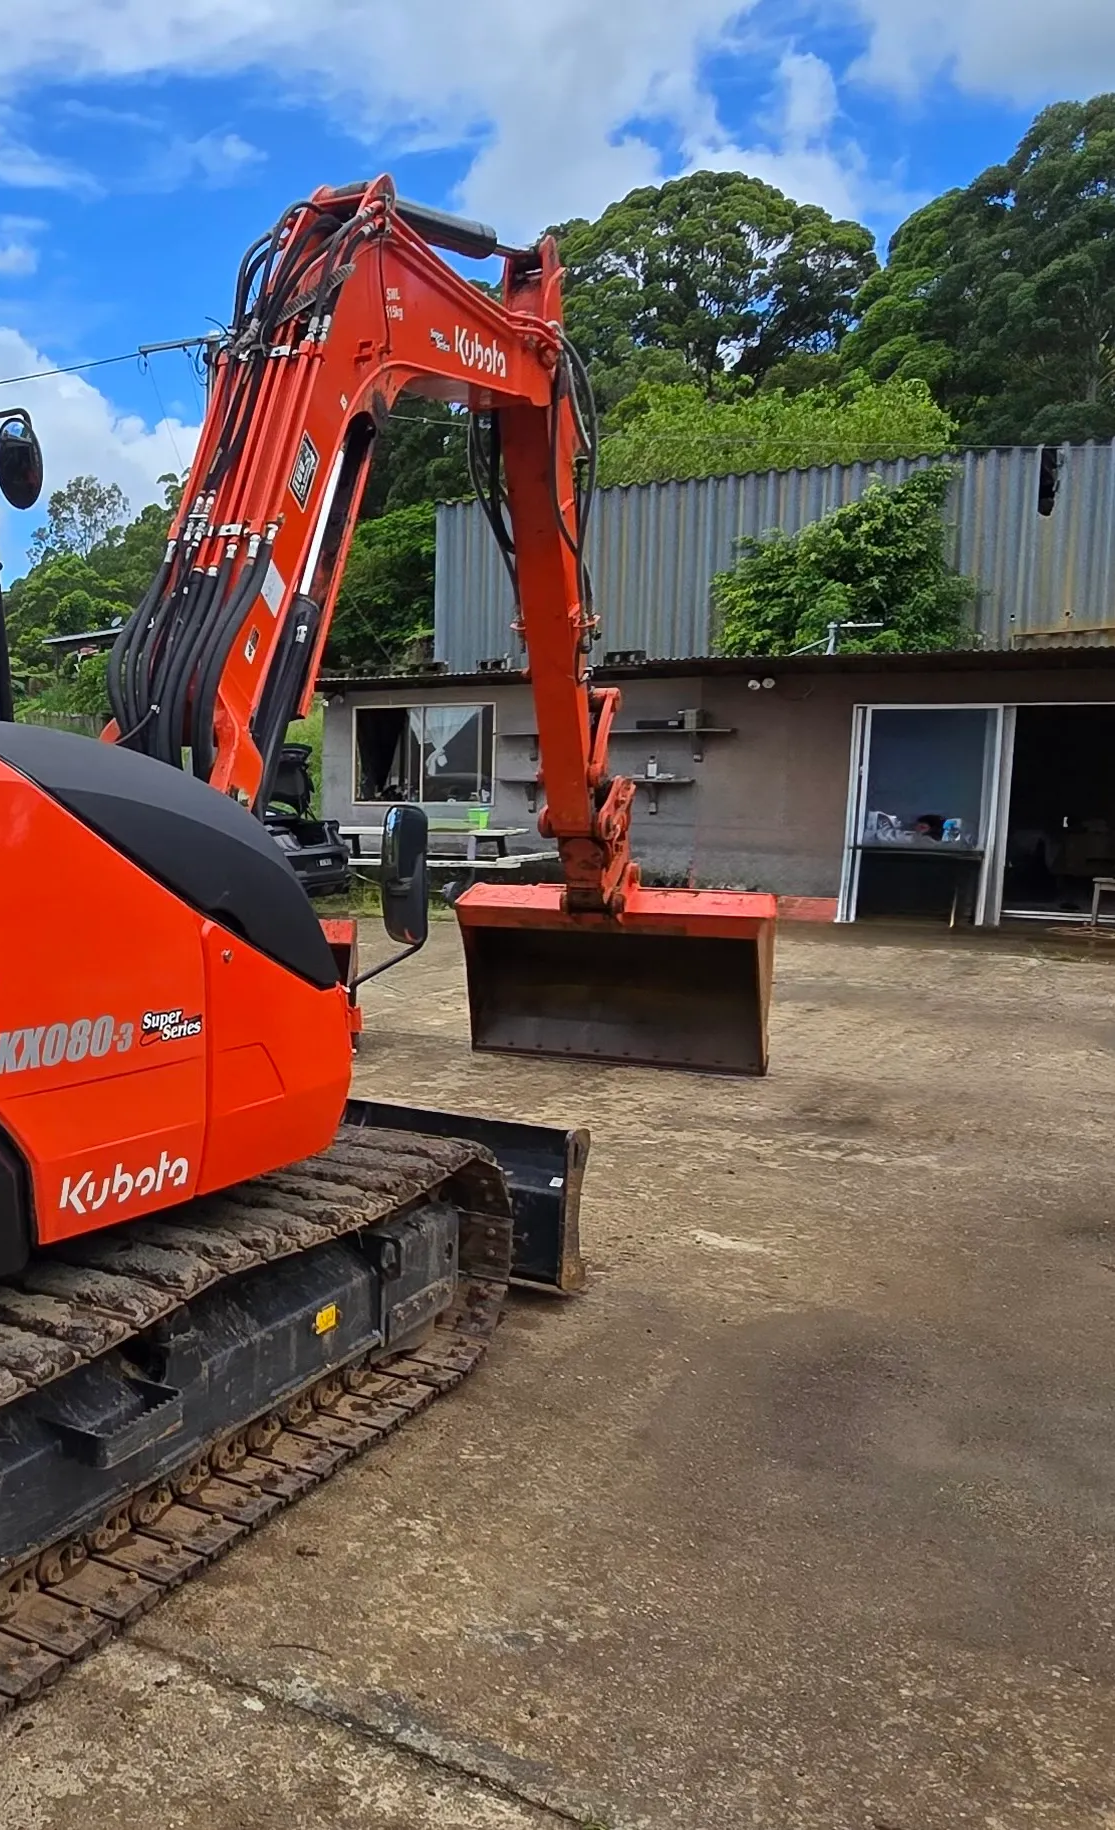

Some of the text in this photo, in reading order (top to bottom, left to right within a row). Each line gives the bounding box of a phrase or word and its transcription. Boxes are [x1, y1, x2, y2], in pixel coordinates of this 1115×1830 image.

[455, 325, 506, 377] Kubota
[143, 1010, 182, 1031] Super
[161, 1020, 202, 1041] Series
[59, 1150, 189, 1214] Kubota
